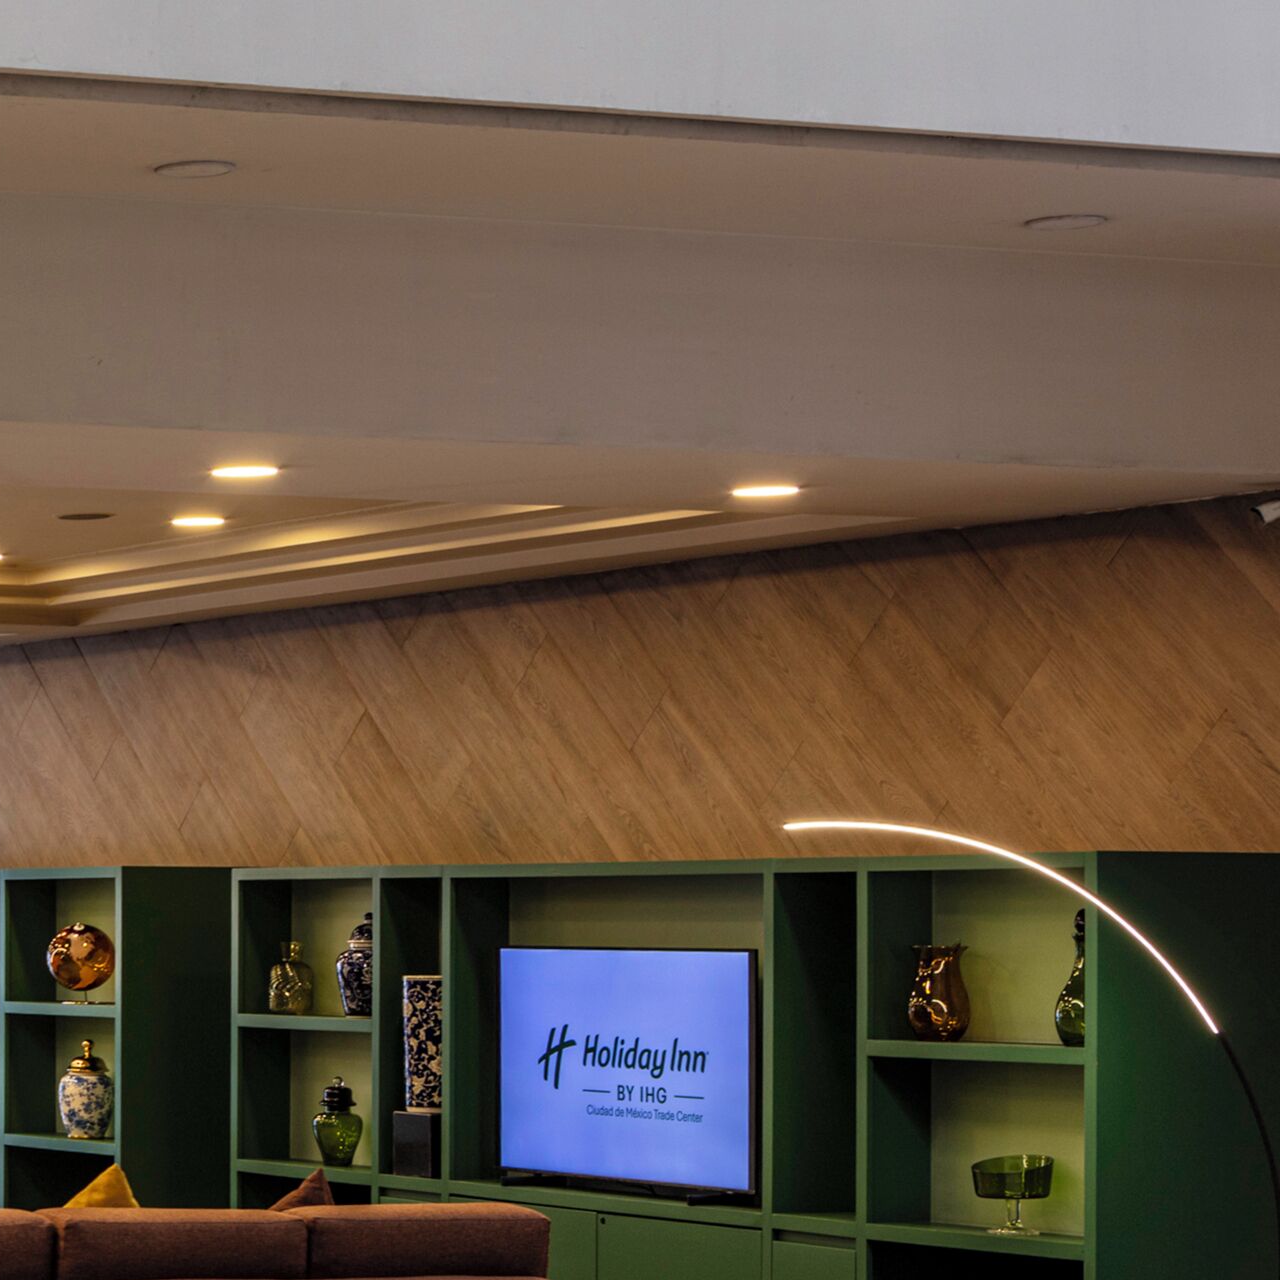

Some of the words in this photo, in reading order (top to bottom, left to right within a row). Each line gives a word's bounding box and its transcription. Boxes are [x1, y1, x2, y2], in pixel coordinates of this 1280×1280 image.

[582, 1033, 667, 1079] Holiday
[670, 1037, 708, 1073] Inn
[616, 1084, 635, 1101] BY
[640, 1086, 668, 1104] IHG
[586, 1104, 614, 1117] Ciudad
[614, 1106, 625, 1118] de
[626, 1107, 653, 1120] México
[653, 1109, 675, 1121] Trade
[676, 1110, 704, 1123] Center
